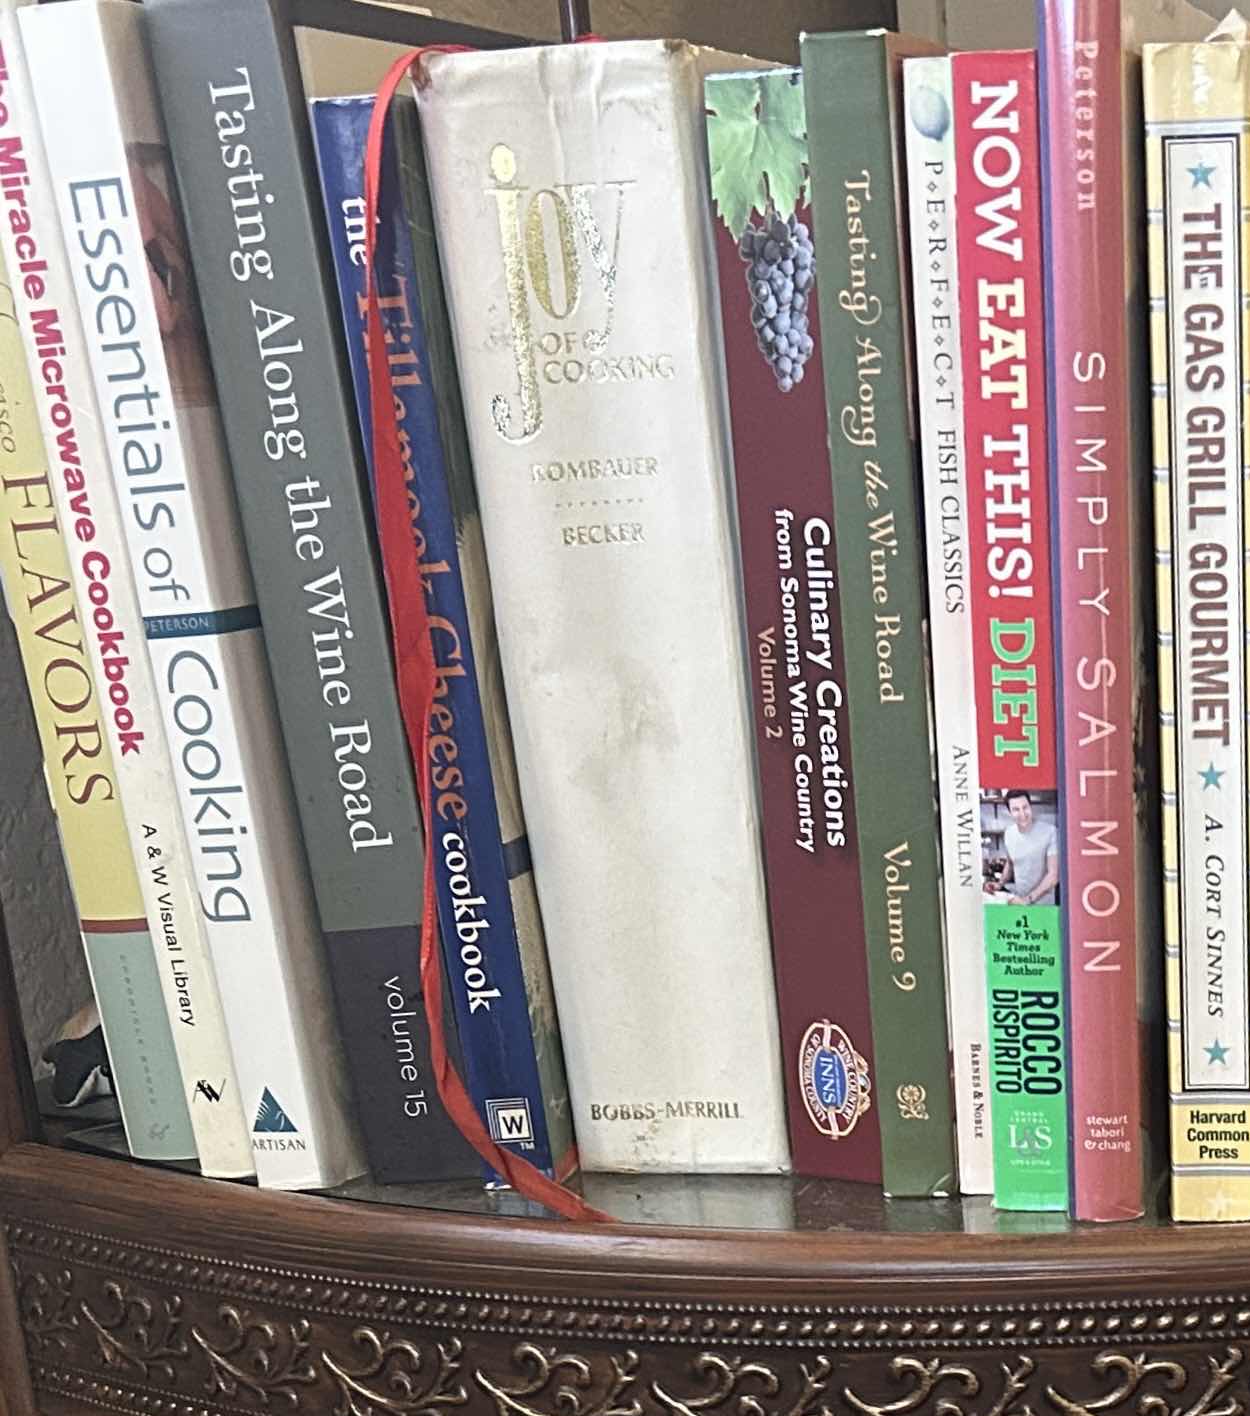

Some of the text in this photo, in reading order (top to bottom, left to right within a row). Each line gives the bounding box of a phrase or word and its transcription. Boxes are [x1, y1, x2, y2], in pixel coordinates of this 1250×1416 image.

[1073, 40, 1099, 211] Peterson
[209, 67, 393, 852] Tasting Along the Wine Road
[530, 457, 659, 483] ROMBAUER
[839, 169, 904, 704] Tasting Along Wine Road
[936, 429, 961, 490] FISH
[970, 81, 1038, 767] NOW EAT THIS! DIET
[1183, 203, 1230, 746] THE GAS GRILL GOURMET
[30, 309, 145, 756] Microwave Cookbook
[68, 176, 253, 923] Essentials of Cooking
[561, 523, 646, 546] BECKER
[2, 470, 113, 806] FLAVORS
[758, 627, 782, 719] Volume
[775, 509, 815, 855] from Sonoma Wine Country
[803, 517, 849, 847] Culinary Creations
[1073, 352, 1121, 974] SIMPLY SALMON
[951, 745, 974, 888] ANNE WILLAN
[157, 891, 196, 1027] Visual Library
[443, 833, 501, 1015] cookbook
[883, 842, 910, 965] Volume
[1204, 853, 1225, 1018] CORT SINNES
[384, 976, 428, 1117] volume 15
[591, 1102, 742, 1121] BOBBS-MERRILL
[992, 988, 1023, 1094] DISPIRITO
[1020, 990, 1063, 1096] ROCCO
[252, 1138, 306, 1152] ARTISAN
[1186, 1126, 1250, 1144] Common
[1190, 1109, 1246, 1125] Harvard
[1199, 1144, 1239, 1160] Press
